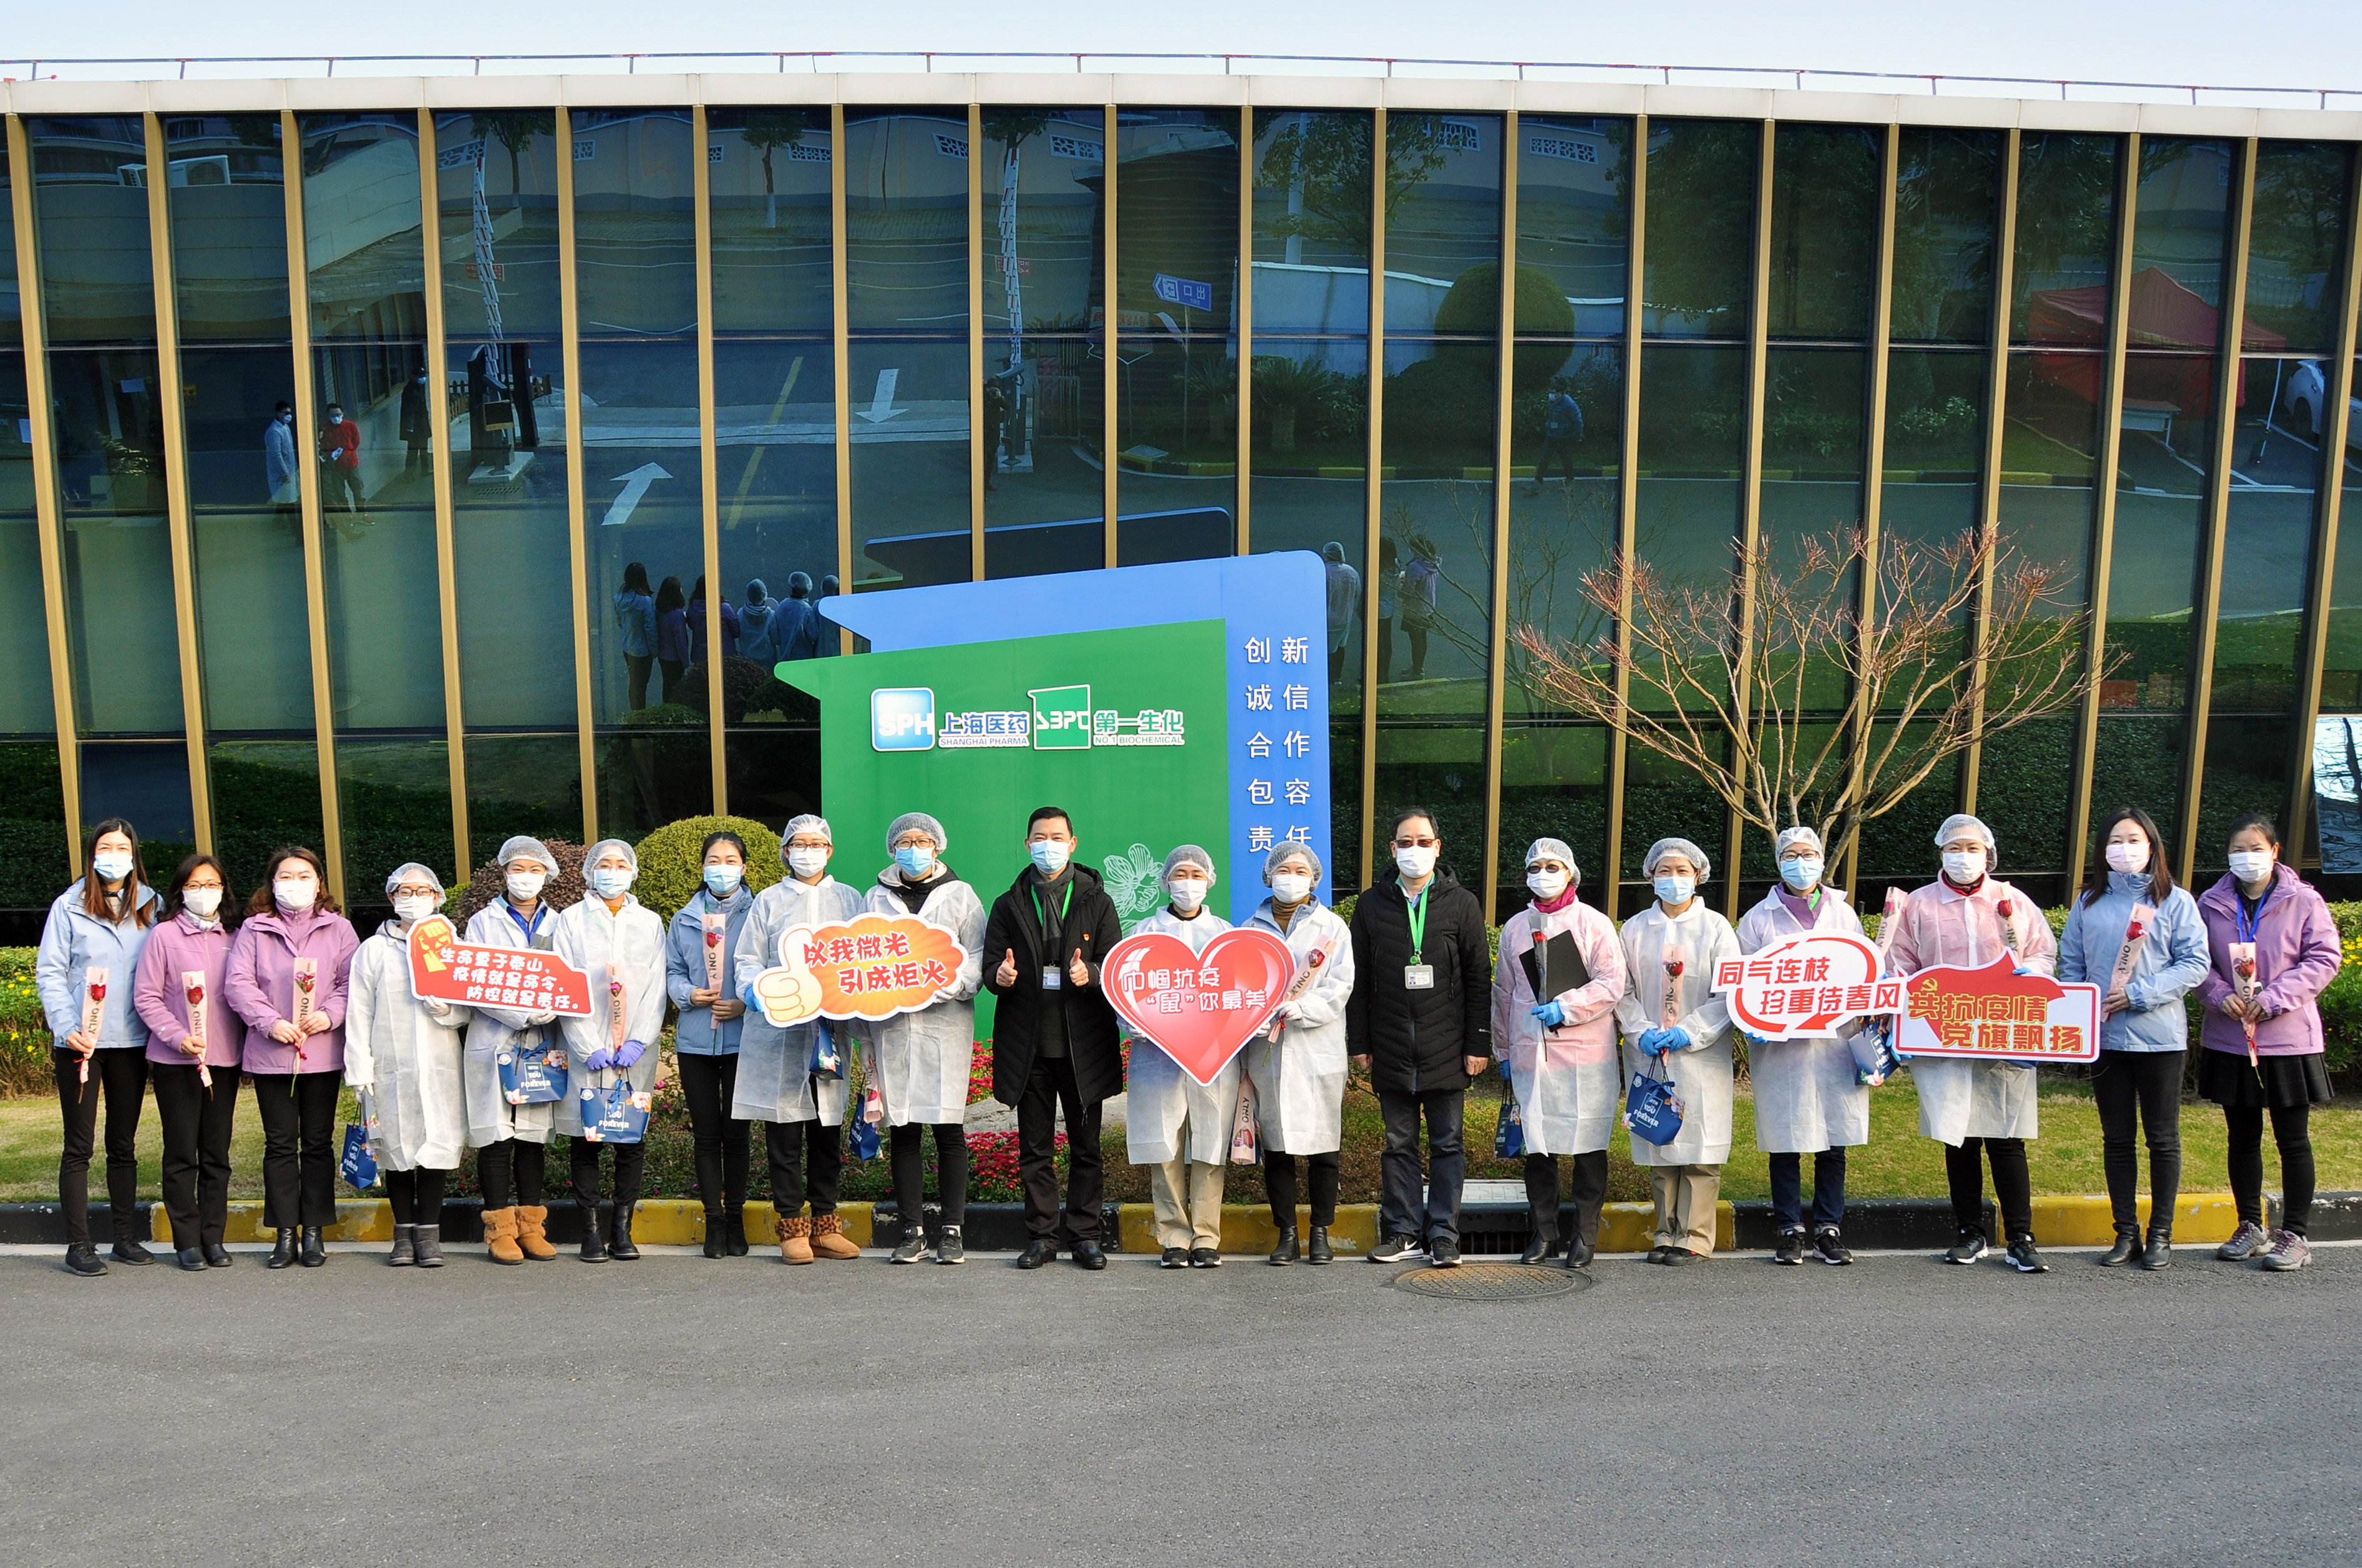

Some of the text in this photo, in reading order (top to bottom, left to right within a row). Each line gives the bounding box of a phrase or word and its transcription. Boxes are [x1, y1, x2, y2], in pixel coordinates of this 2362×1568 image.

[1245, 636, 1309, 664] 创新
[1245, 684, 1310, 711] 诚信
[878, 713, 933, 737] SPH
[941, 713, 1028, 735] 上海医药
[1096, 712, 1182, 733] 第一生化
[1247, 730, 1310, 758] 合作
[1247, 778, 1311, 805] 包容
[1877, 921, 1888, 947] ONLY
[804, 932, 910, 966] 以我微光
[2118, 945, 2131, 974] ONLY
[708, 952, 717, 979] ONLY
[839, 959, 948, 995] 引成炬火
[1123, 966, 1221, 992] 巾帼抗疫
[1718, 957, 1830, 987] 同气连枝
[1291, 970, 1310, 996] ONLY
[613, 1000, 621, 1025] ONLY
[1759, 983, 1901, 1015] 珍重待春风
[1908, 992, 2048, 1024] 共抗疫情
[88, 1008, 99, 1034] ONLY
[1942, 1020, 2083, 1053] 党旗飘扬
[520, 1080, 551, 1088] FOREVER
[1242, 1096, 1250, 1123] ONLY
[1633, 1109, 1659, 1128] FOREVER
[1644, 1103, 1656, 1114] YOU
[598, 1120, 629, 1128] FOREVER
